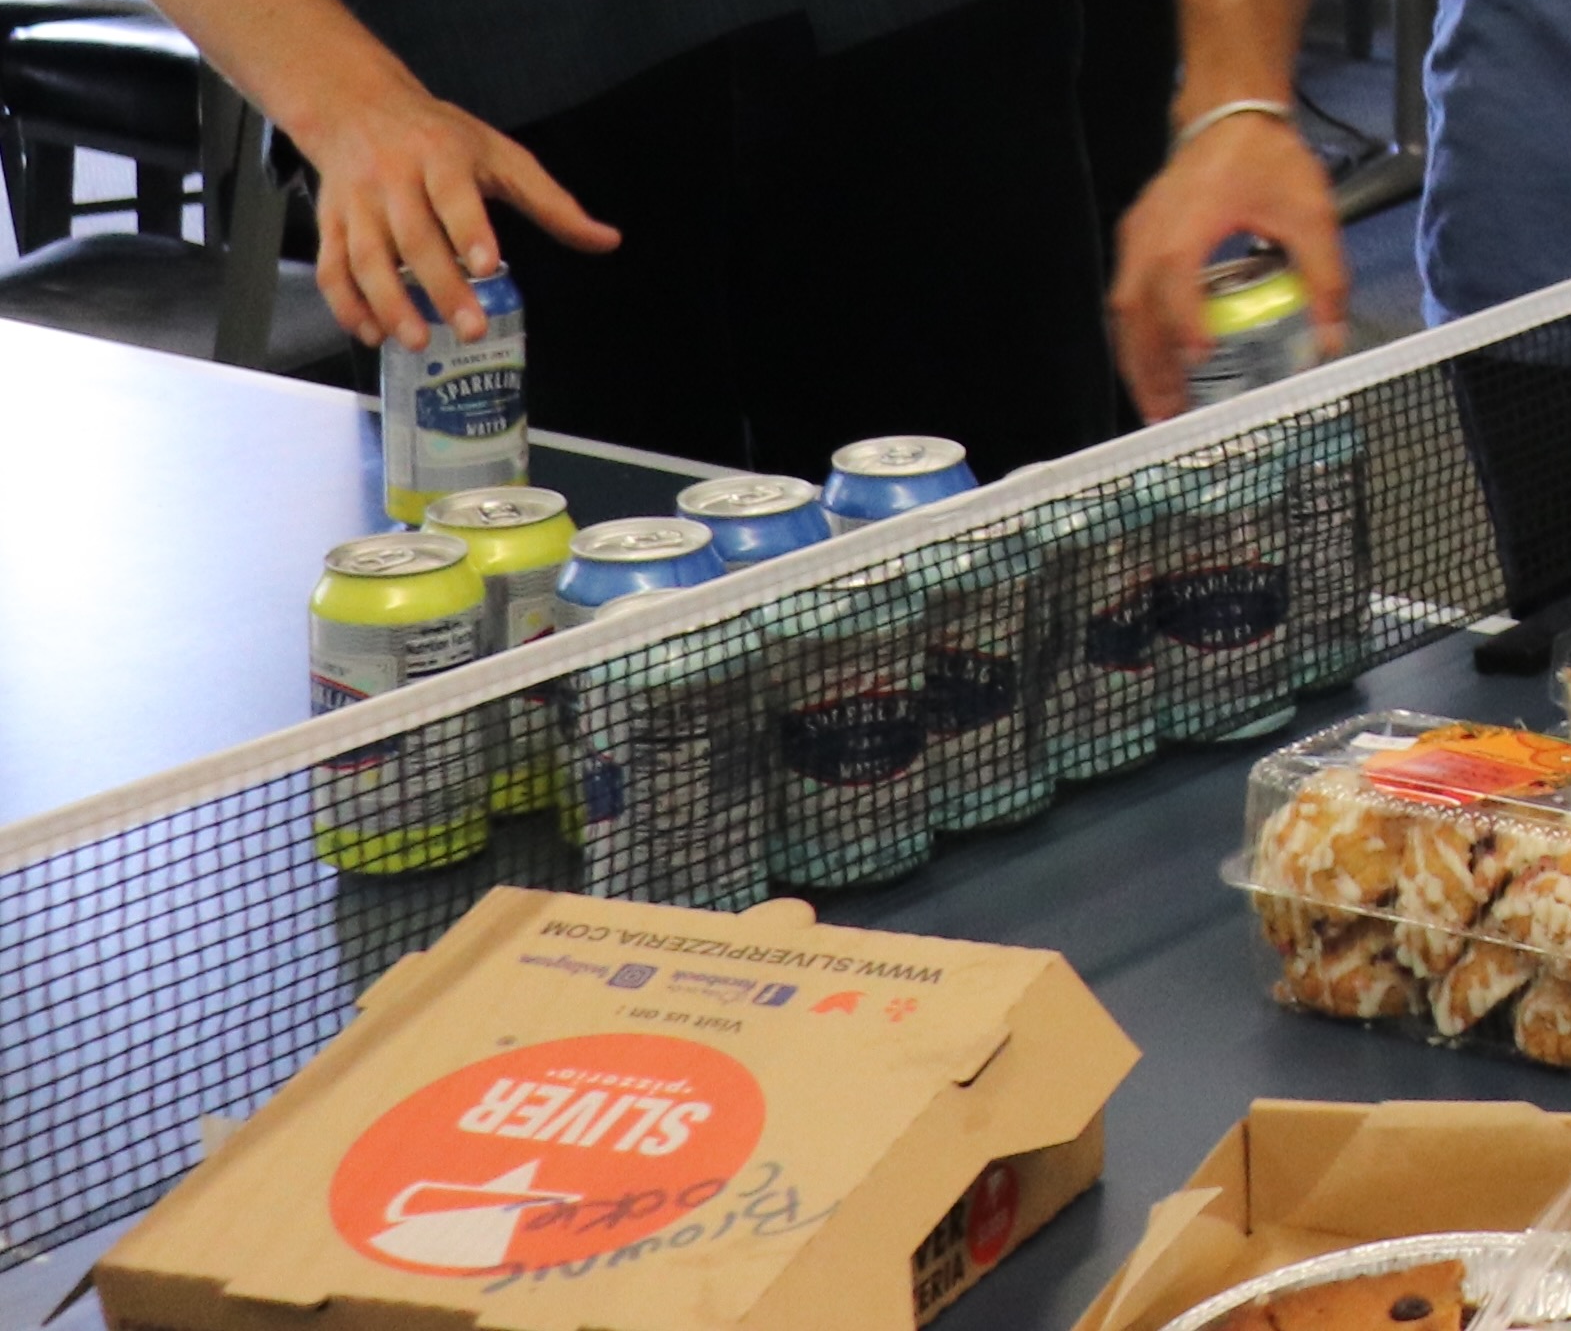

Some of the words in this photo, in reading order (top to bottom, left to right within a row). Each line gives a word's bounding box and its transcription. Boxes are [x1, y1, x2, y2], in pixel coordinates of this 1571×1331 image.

[436, 369, 522, 405] SPARKLIN
[541, 920, 944, 985] WWW.SLIVERPIZZERIA.COM
[665, 1010, 690, 1024] us
[695, 1015, 744, 1034] Visit
[457, 1076, 712, 1157] SLIVER
[914, 1198, 966, 1273] VER
